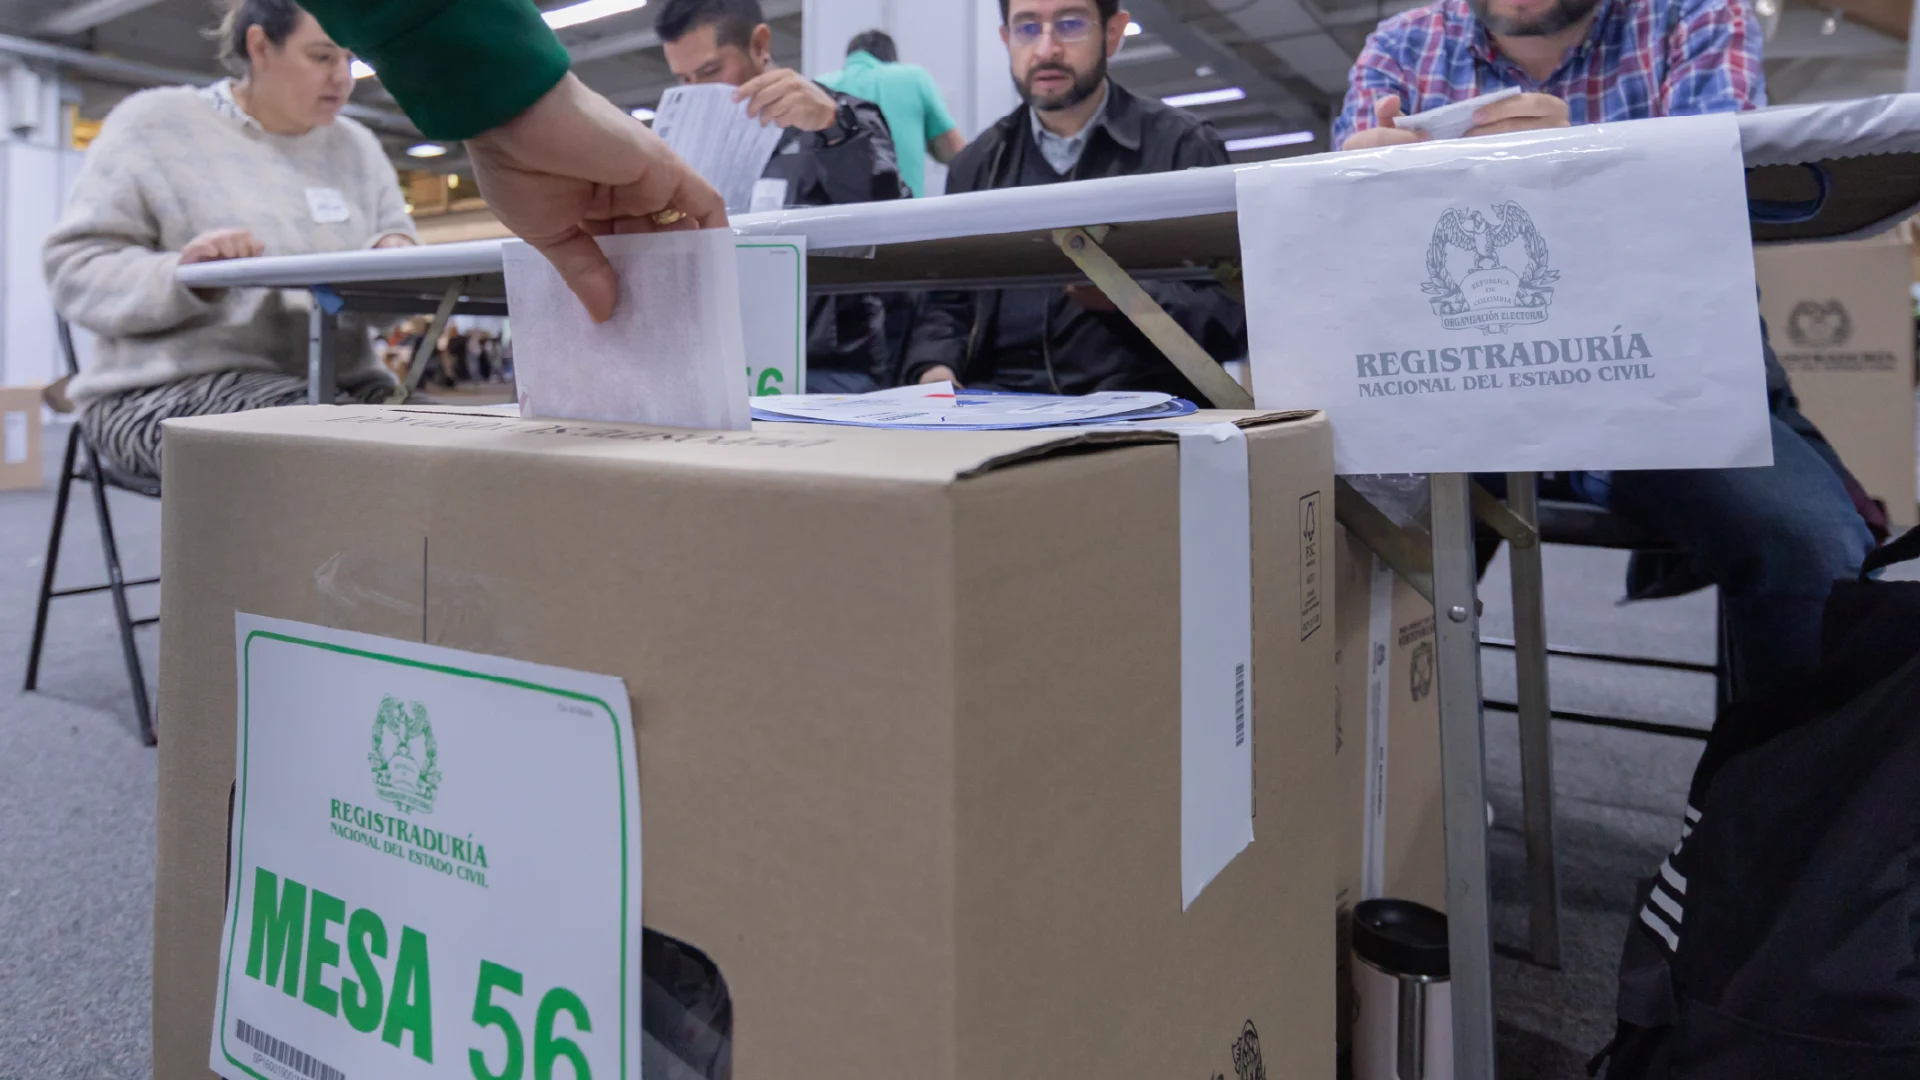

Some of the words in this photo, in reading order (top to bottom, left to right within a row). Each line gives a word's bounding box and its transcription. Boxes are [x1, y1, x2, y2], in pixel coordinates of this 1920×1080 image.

[1443, 310, 1499, 328] ORGANIZACIÓN
[1501, 310, 1546, 321] ELECTORAL
[1473, 295, 1512, 306] COLOMBIA
[1355, 324, 1654, 378] REGISTRADURÍA
[1358, 377, 1456, 398] NACIONAL
[1462, 373, 1503, 391] DEL
[1508, 368, 1592, 388] ESTADO
[1597, 363, 1656, 382] CIVIL
[330, 798, 489, 868] REGISTRADURÍA
[330, 821, 381, 851] NACIONAL
[383, 840, 406, 859] DEL
[408, 849, 453, 876] ESTADO
[456, 865, 490, 888] CIVIL
[245, 865, 434, 1065] MESA
[468, 958, 593, 1080] 56
